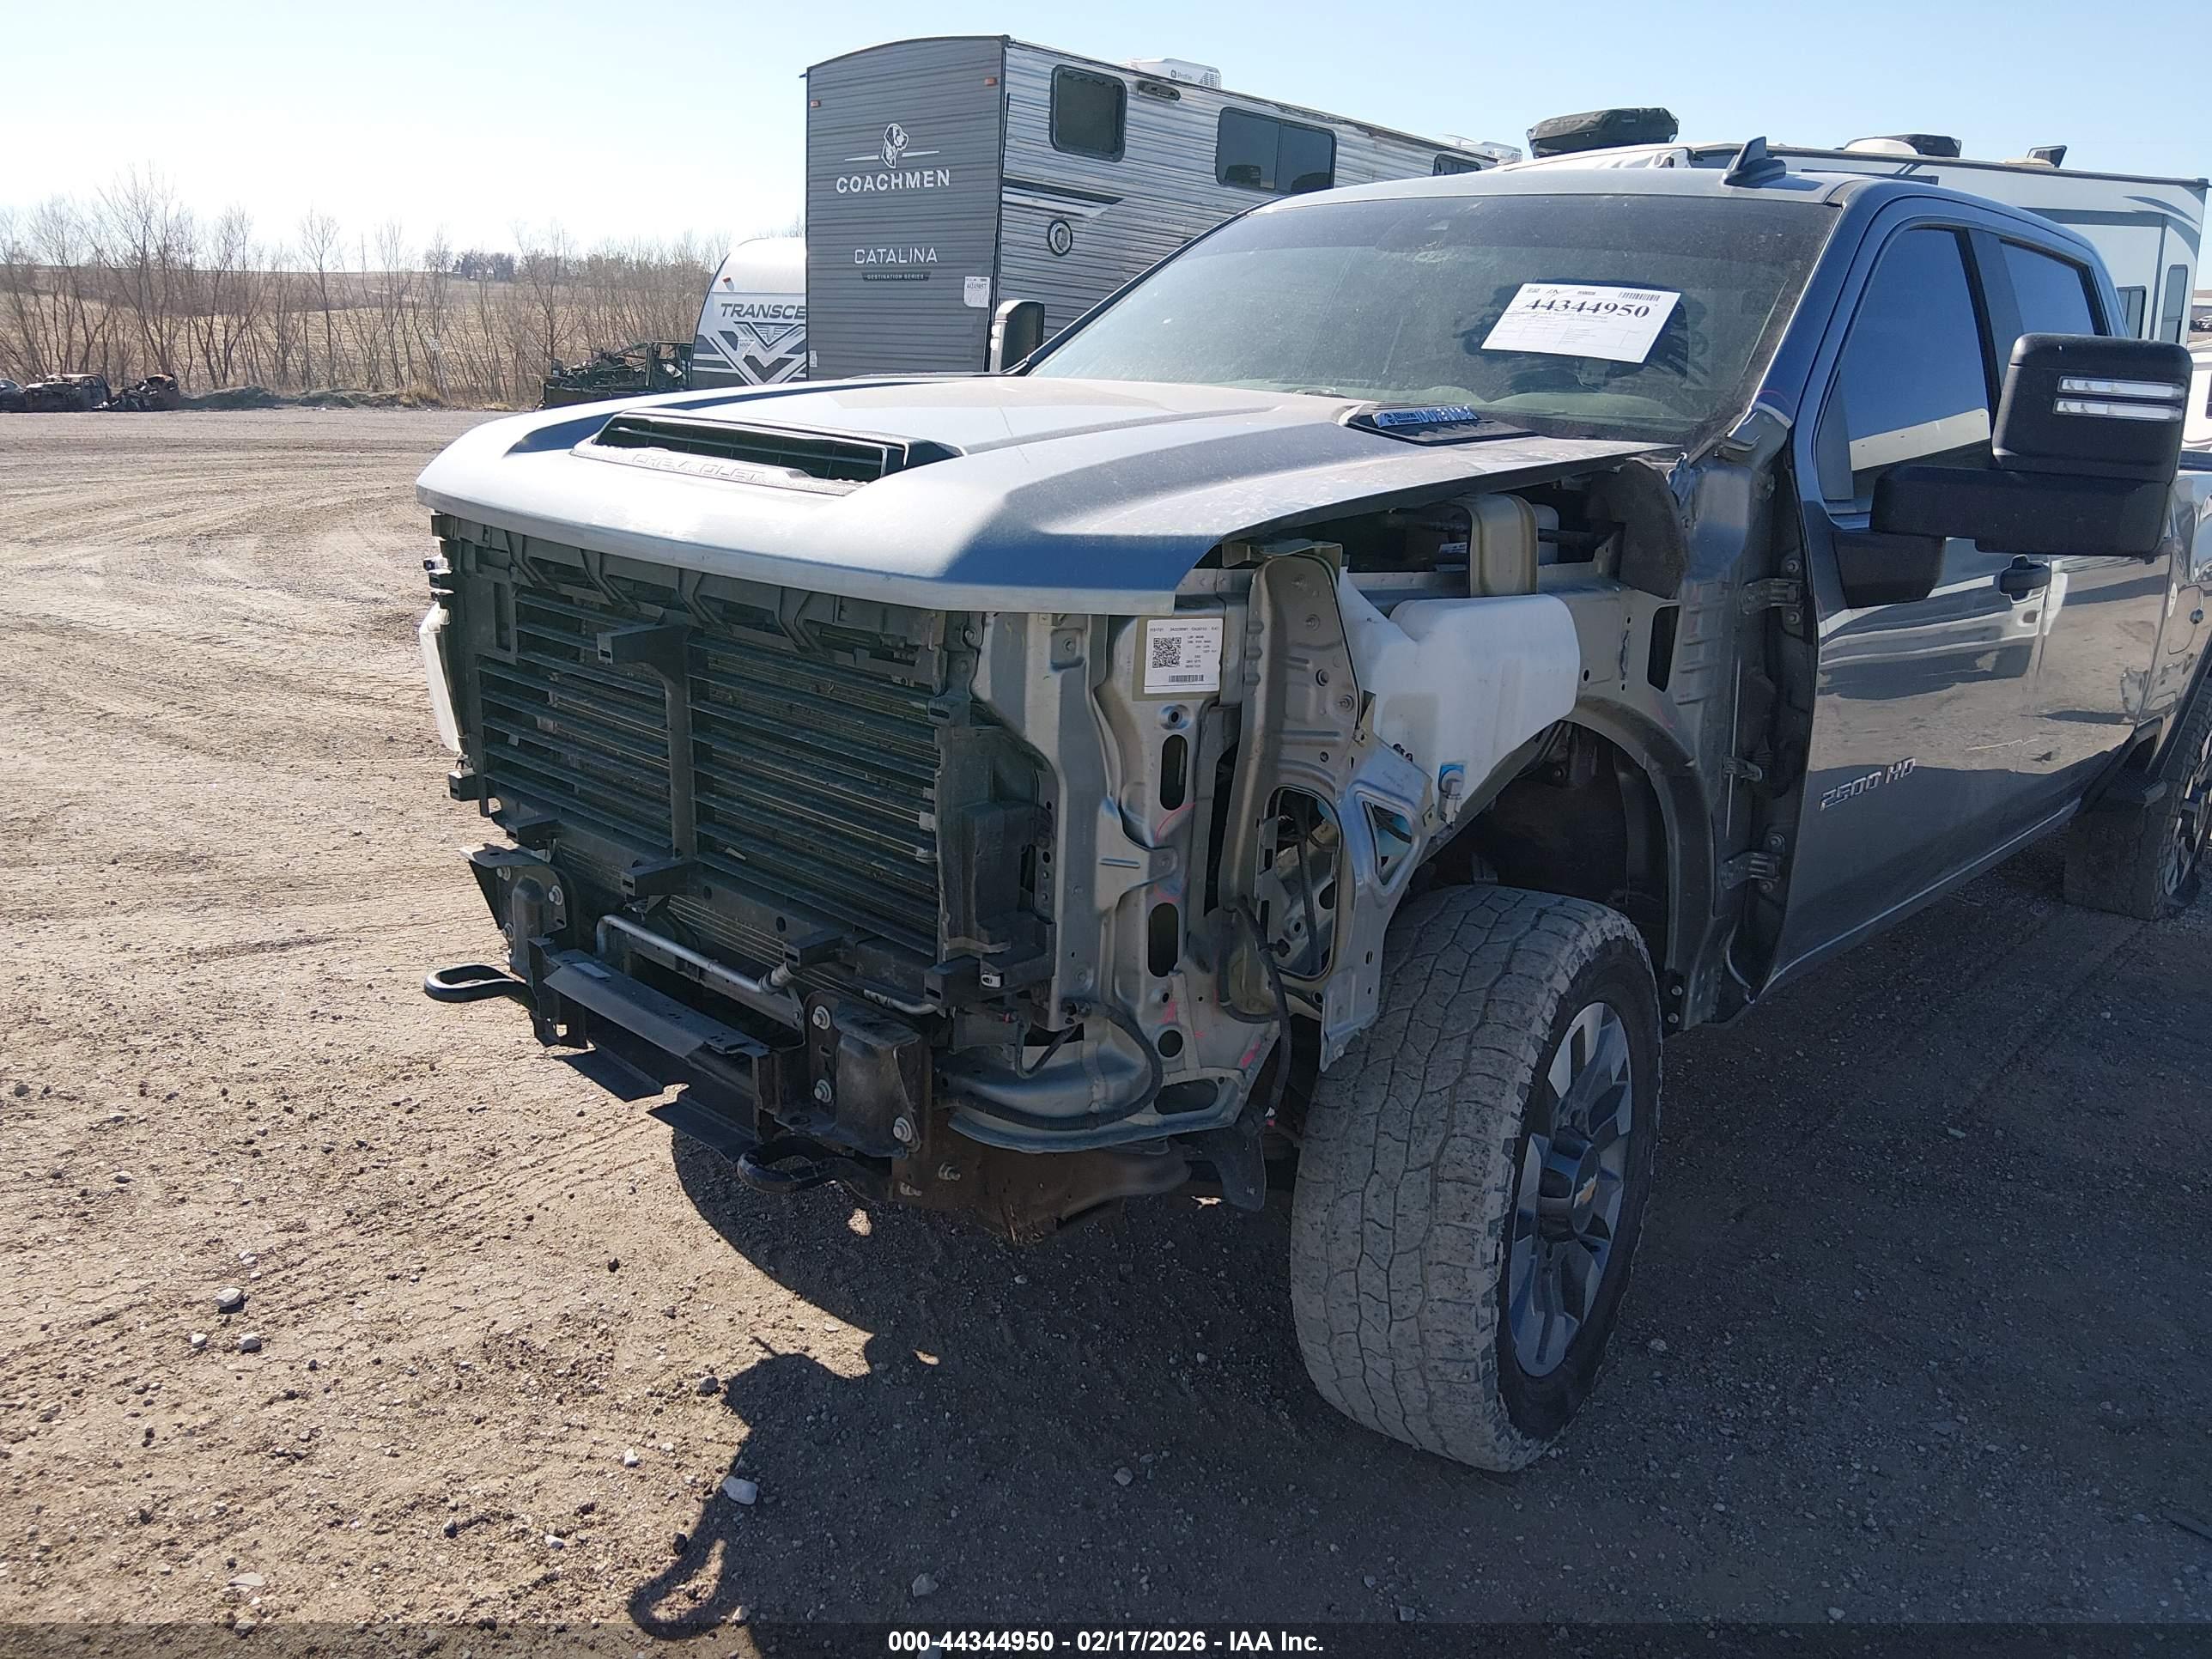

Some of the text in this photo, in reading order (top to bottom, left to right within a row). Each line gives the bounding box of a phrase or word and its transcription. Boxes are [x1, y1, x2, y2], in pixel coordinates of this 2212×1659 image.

[836, 169, 950, 194] COACHMEN
[854, 246, 938, 264] CATALINA
[1525, 298, 1651, 319] 44344950
[1820, 757, 1917, 811] 2500 HD
